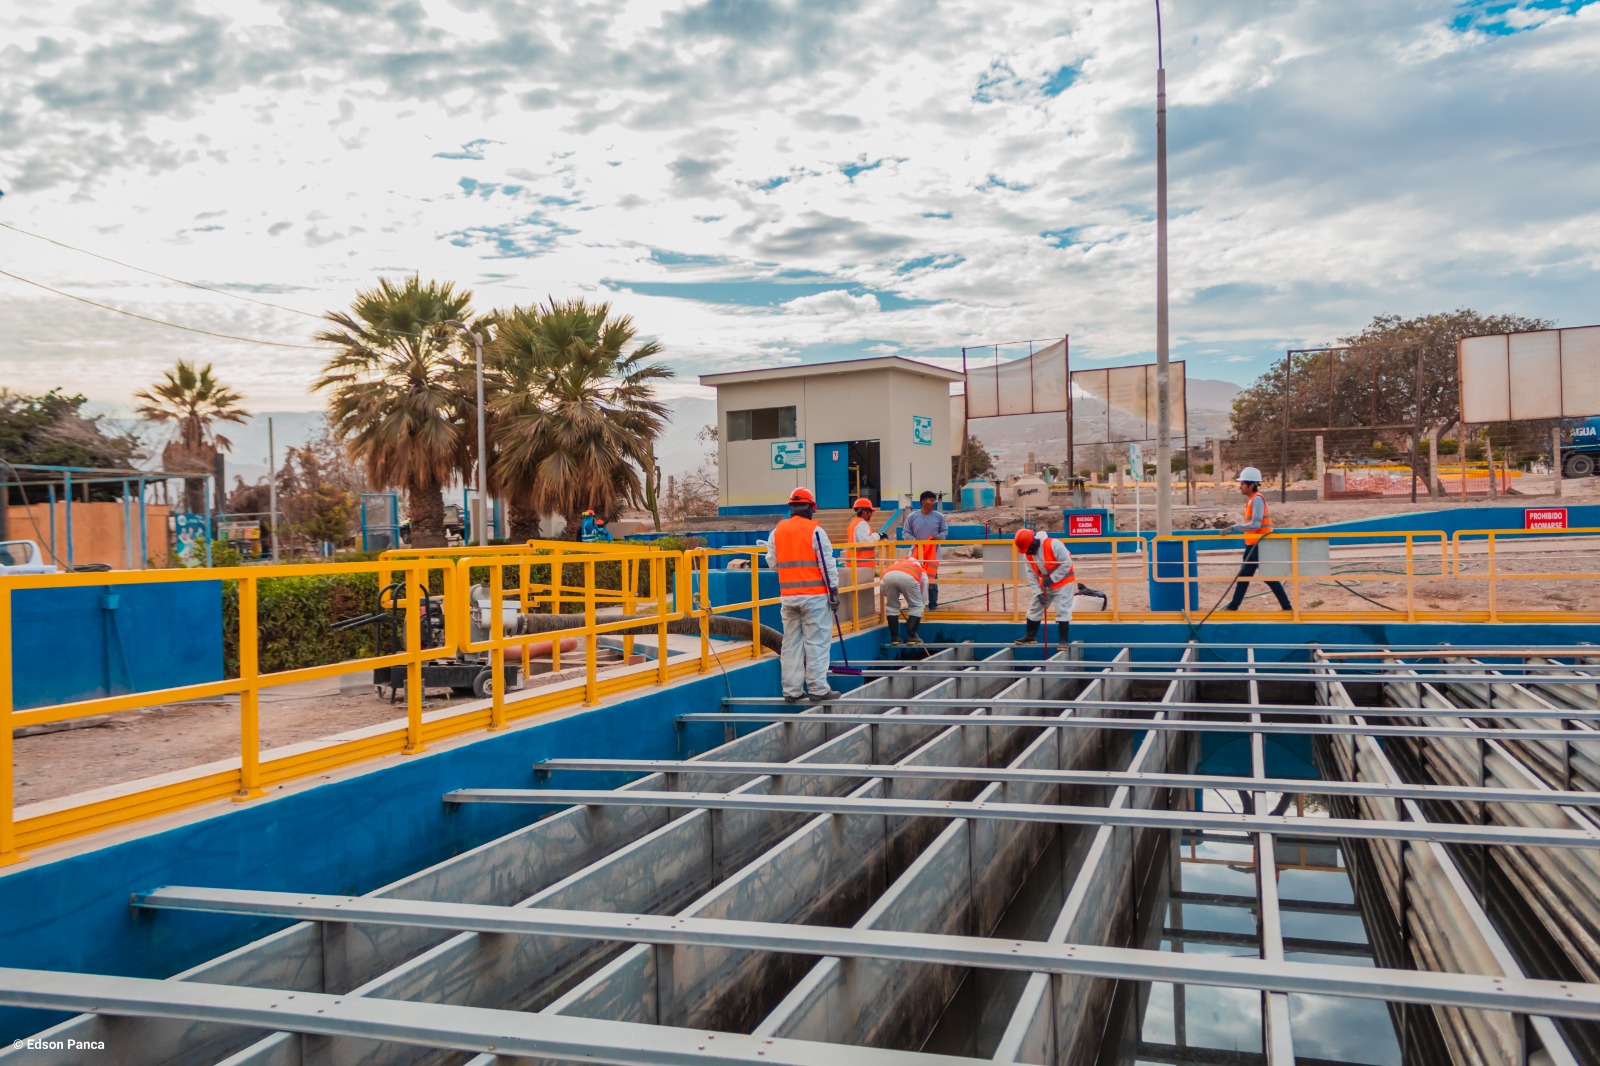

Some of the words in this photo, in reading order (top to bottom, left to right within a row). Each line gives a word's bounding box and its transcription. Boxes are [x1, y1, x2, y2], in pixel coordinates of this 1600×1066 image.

[1569, 427, 1596, 436] AGUA
[1529, 512, 1563, 520] PROHIBIDO
[1530, 521, 1563, 529] ASOMARSE
